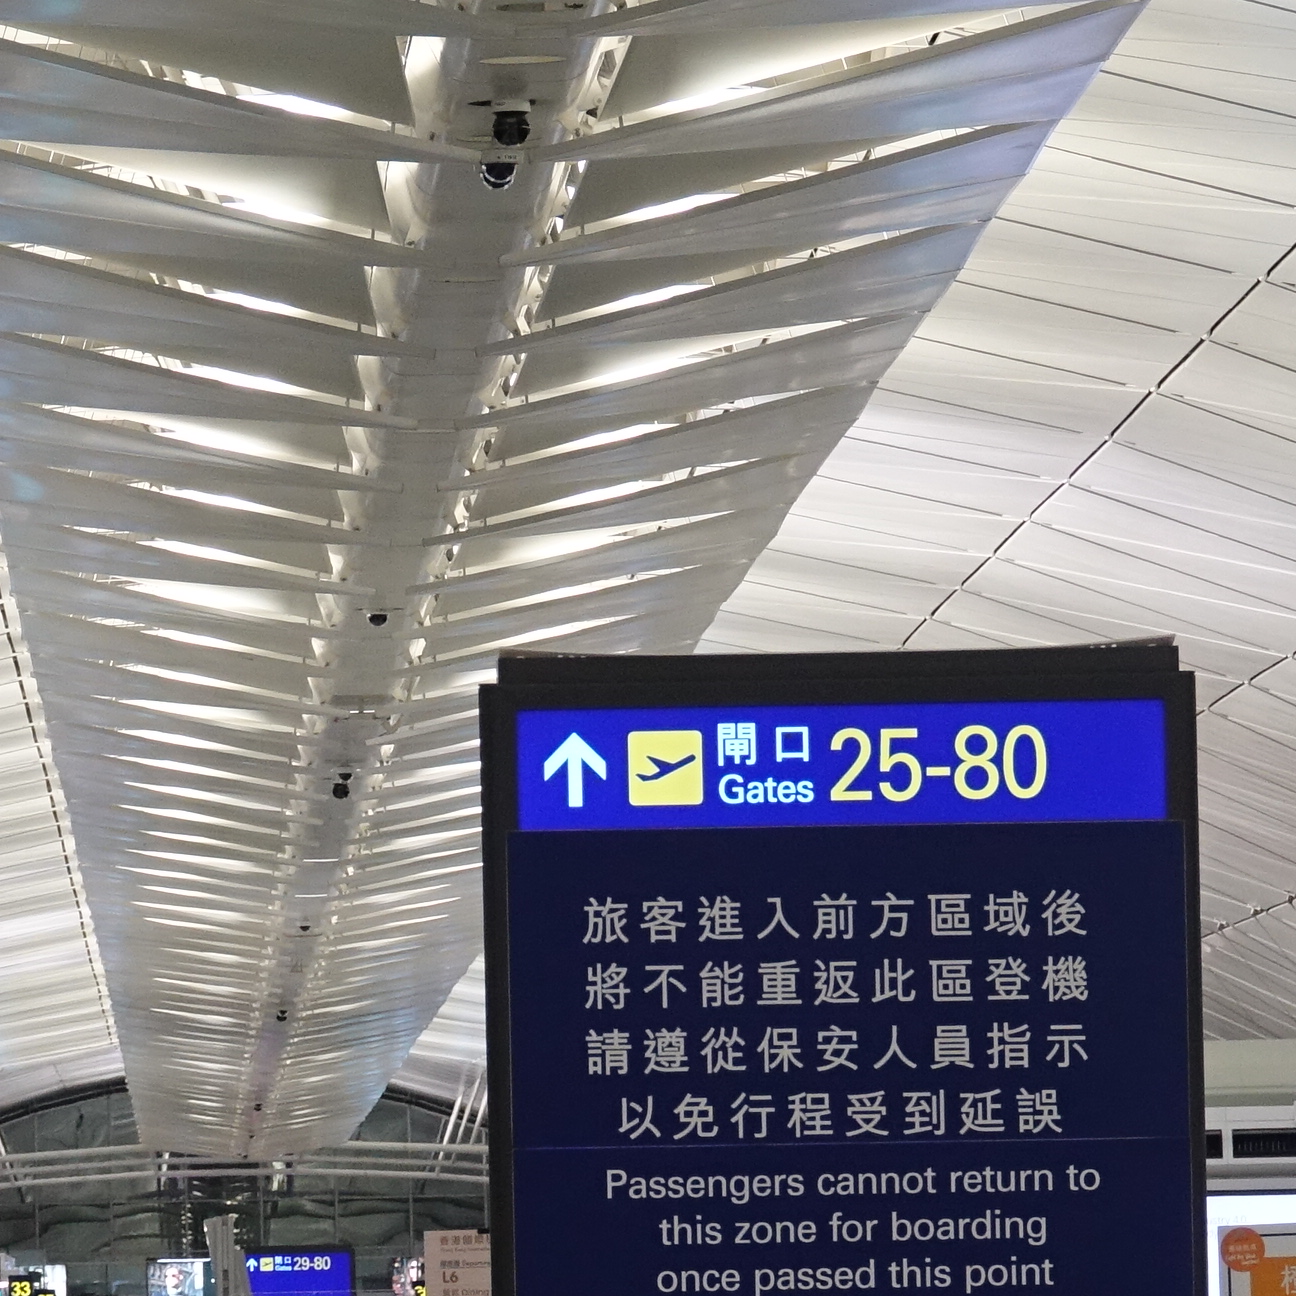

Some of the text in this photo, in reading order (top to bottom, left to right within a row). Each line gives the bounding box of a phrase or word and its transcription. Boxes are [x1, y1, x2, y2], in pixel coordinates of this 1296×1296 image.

[717, 723, 810, 766] 閘口
[830, 725, 1047, 802] 25-80
[719, 774, 814, 804] Gates
[583, 889, 1087, 944] 旅客進入前方區域後
[585, 956, 1088, 1009] 將不能重返此區登機
[586, 1022, 1088, 1075] 請遵從保安人員指示
[618, 1088, 1062, 1139] 以免行程受到延誤
[607, 1165, 1100, 1204] Passengers cannot return to
[659, 1210, 1046, 1245] this zone for boarding
[293, 1256, 331, 1270] 29-80
[442, 1271, 459, 1283] L6
[657, 1256, 1054, 1296] once passed this point
[10, 1281, 31, 1296] 33
